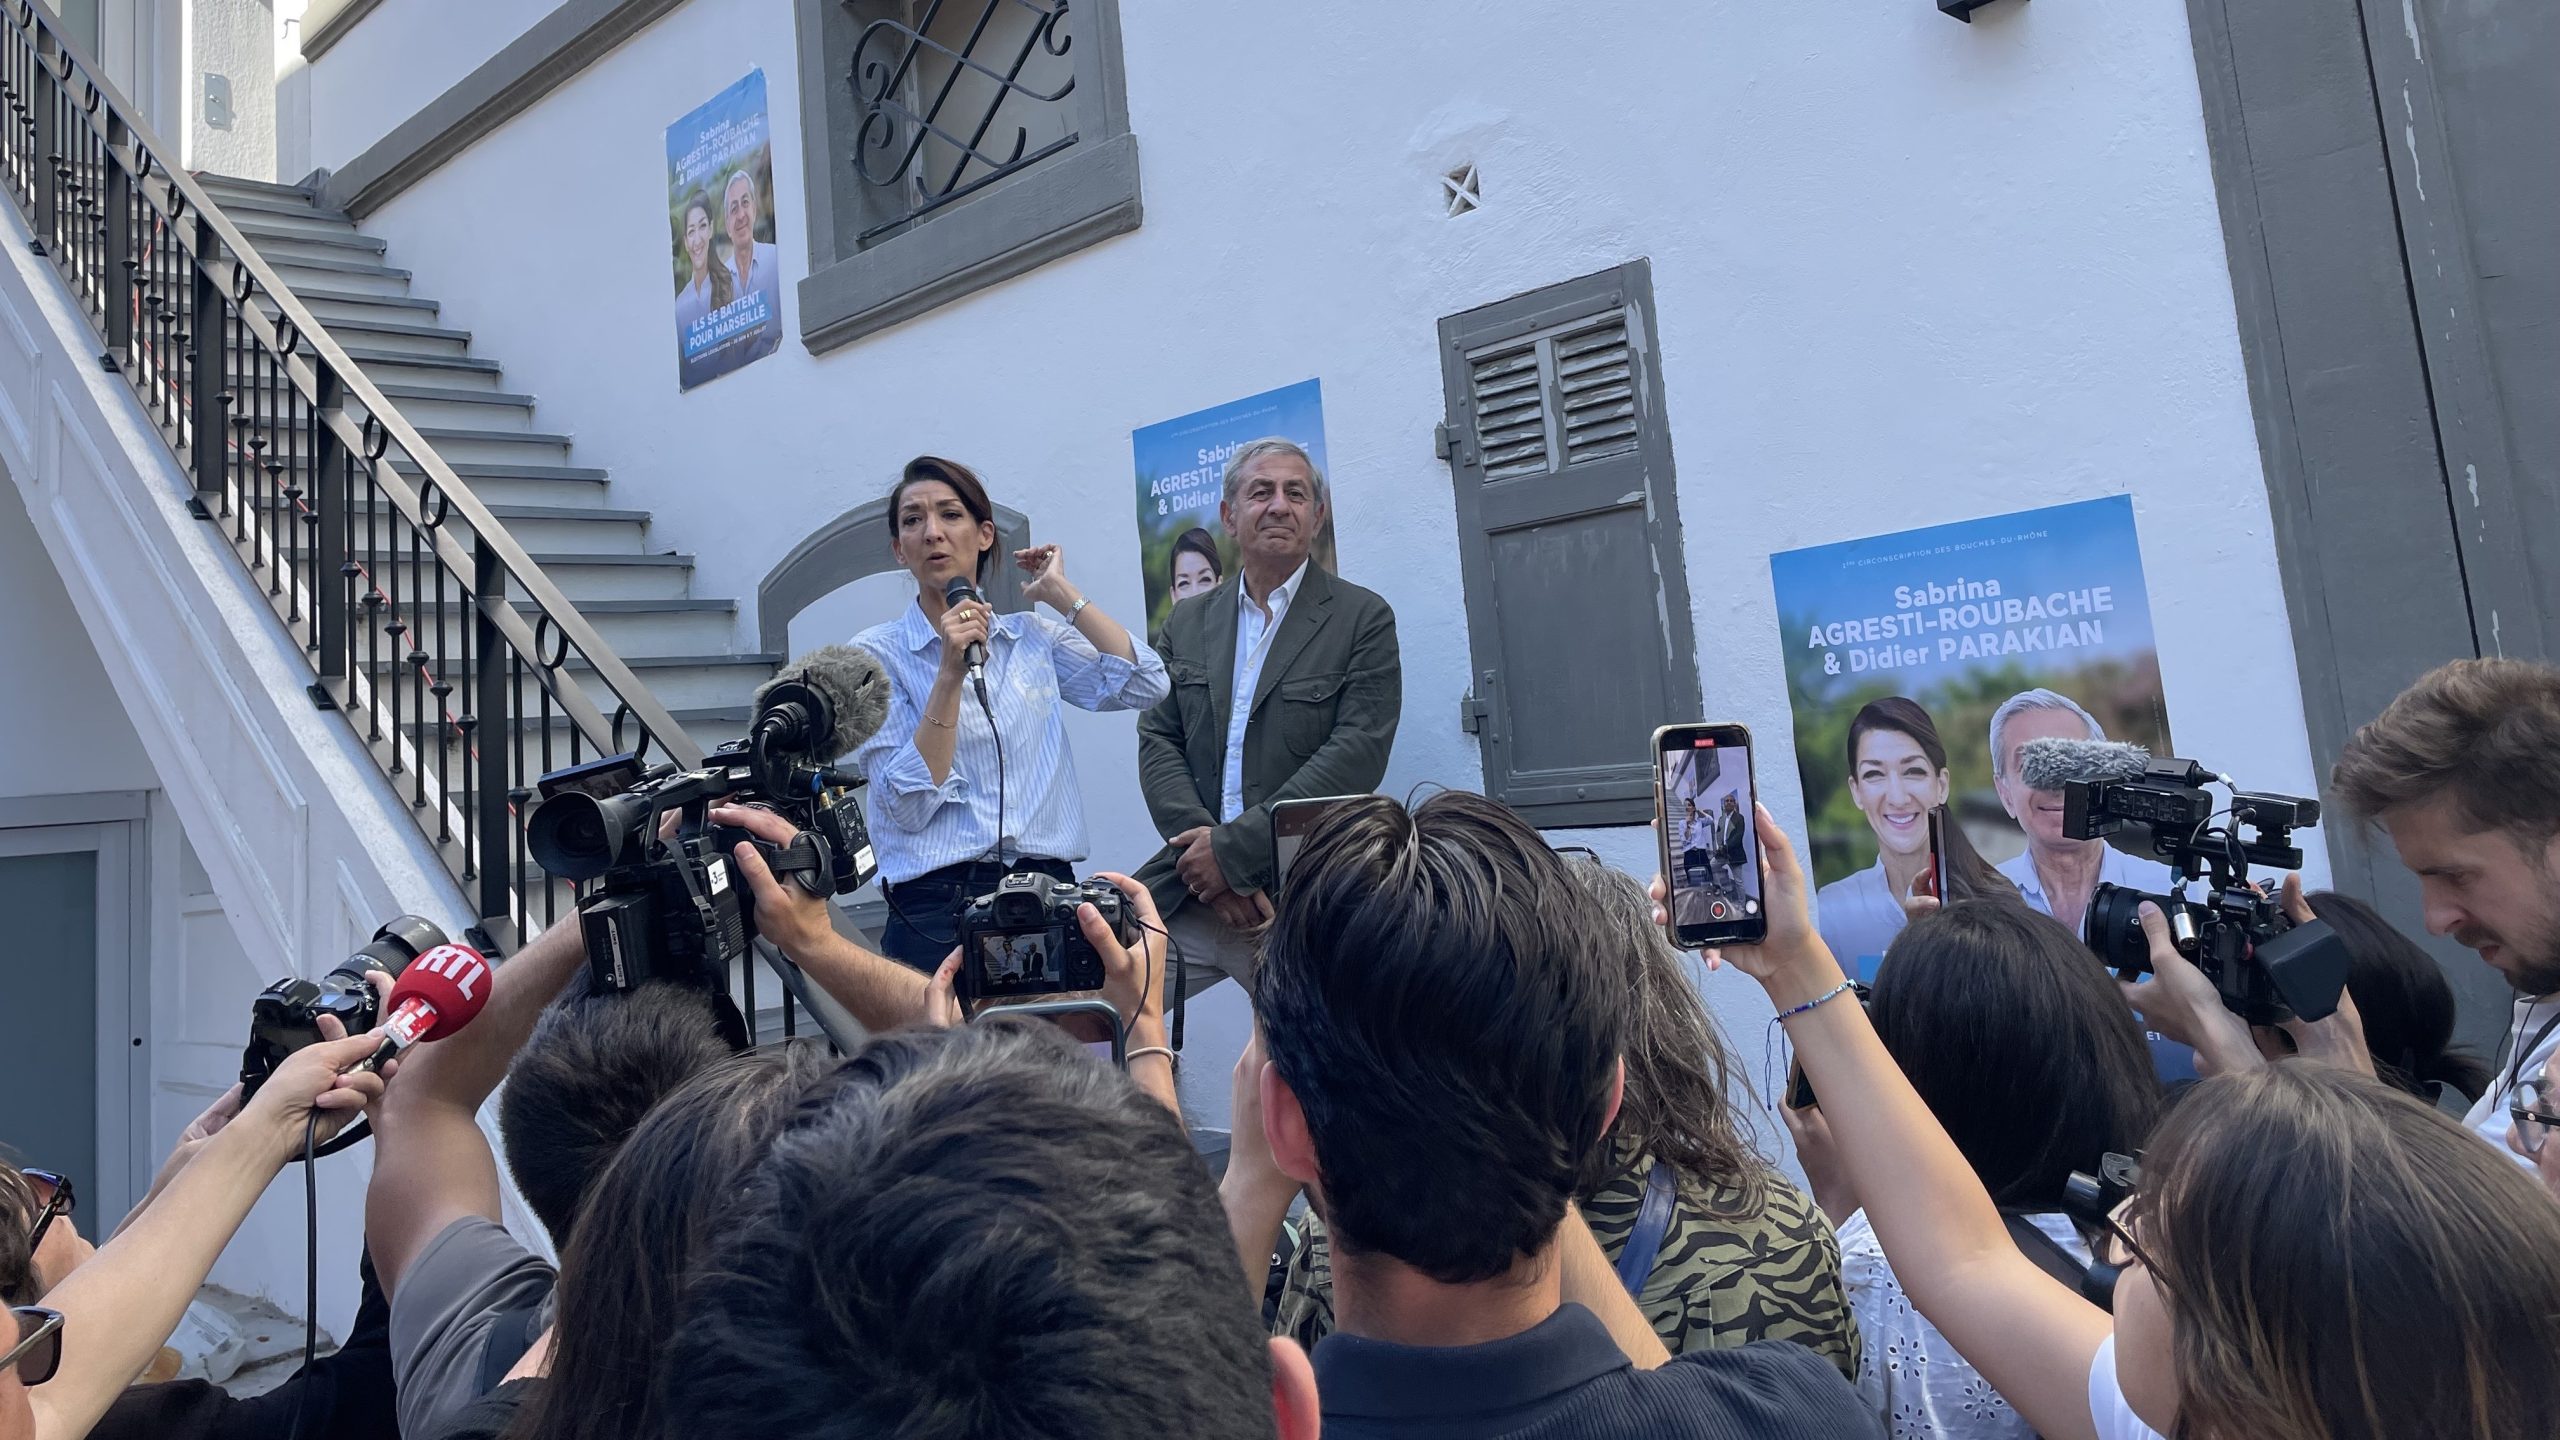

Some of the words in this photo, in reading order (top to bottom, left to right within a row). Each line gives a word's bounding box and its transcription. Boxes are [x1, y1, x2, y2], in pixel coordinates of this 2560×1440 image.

[675, 112, 760, 175] AGRESTI-ROUBACHE
[700, 119, 730, 144] Sabrina
[711, 130, 756, 167] PARAKIAN
[690, 330, 713, 350] POUR
[715, 304, 766, 339] MARSEILLE
[692, 315, 705, 333] ILS
[707, 309, 719, 325] SE
[720, 290, 760, 320] BATTENT
[1198, 440, 1244, 466] Sabri
[1158, 498, 1168, 516] &
[1172, 489, 1217, 513] Didier
[1857, 549, 1932, 568] CIRCONSCRIPTION
[1934, 545, 1952, 555] DES
[1894, 577, 2001, 609] Sabrina
[1808, 585, 2114, 649] AGRESTI-ROUBACHE
[1823, 652, 1841, 675] &
[1849, 644, 1929, 672] Didier
[1938, 620, 2104, 662] PARAKIAN
[415, 945, 485, 1001] RTL
